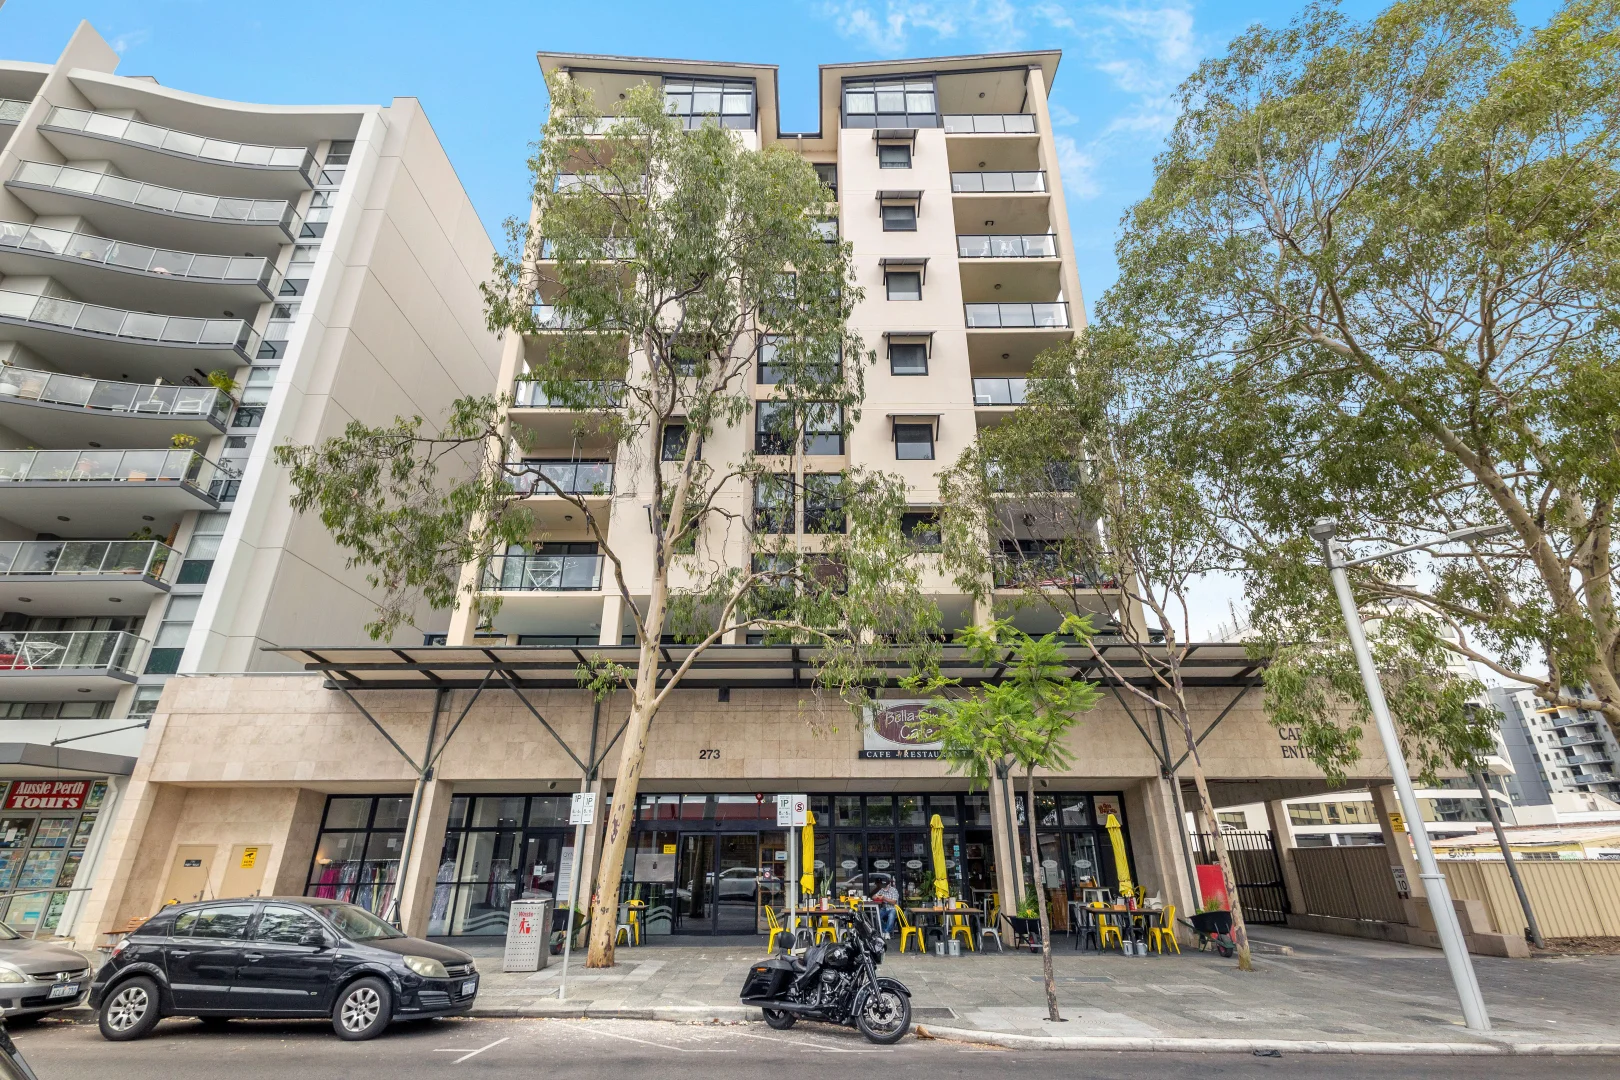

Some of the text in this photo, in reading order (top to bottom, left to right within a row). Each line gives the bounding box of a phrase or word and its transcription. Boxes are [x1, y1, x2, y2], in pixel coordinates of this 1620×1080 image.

[885, 709, 915, 725] Bella
[699, 749, 721, 760] 273
[866, 750, 891, 758] CAFE
[15, 781, 85, 795] Aussie Perth
[12, 795, 80, 809] Tours
[1397, 880, 1408, 891] 10
